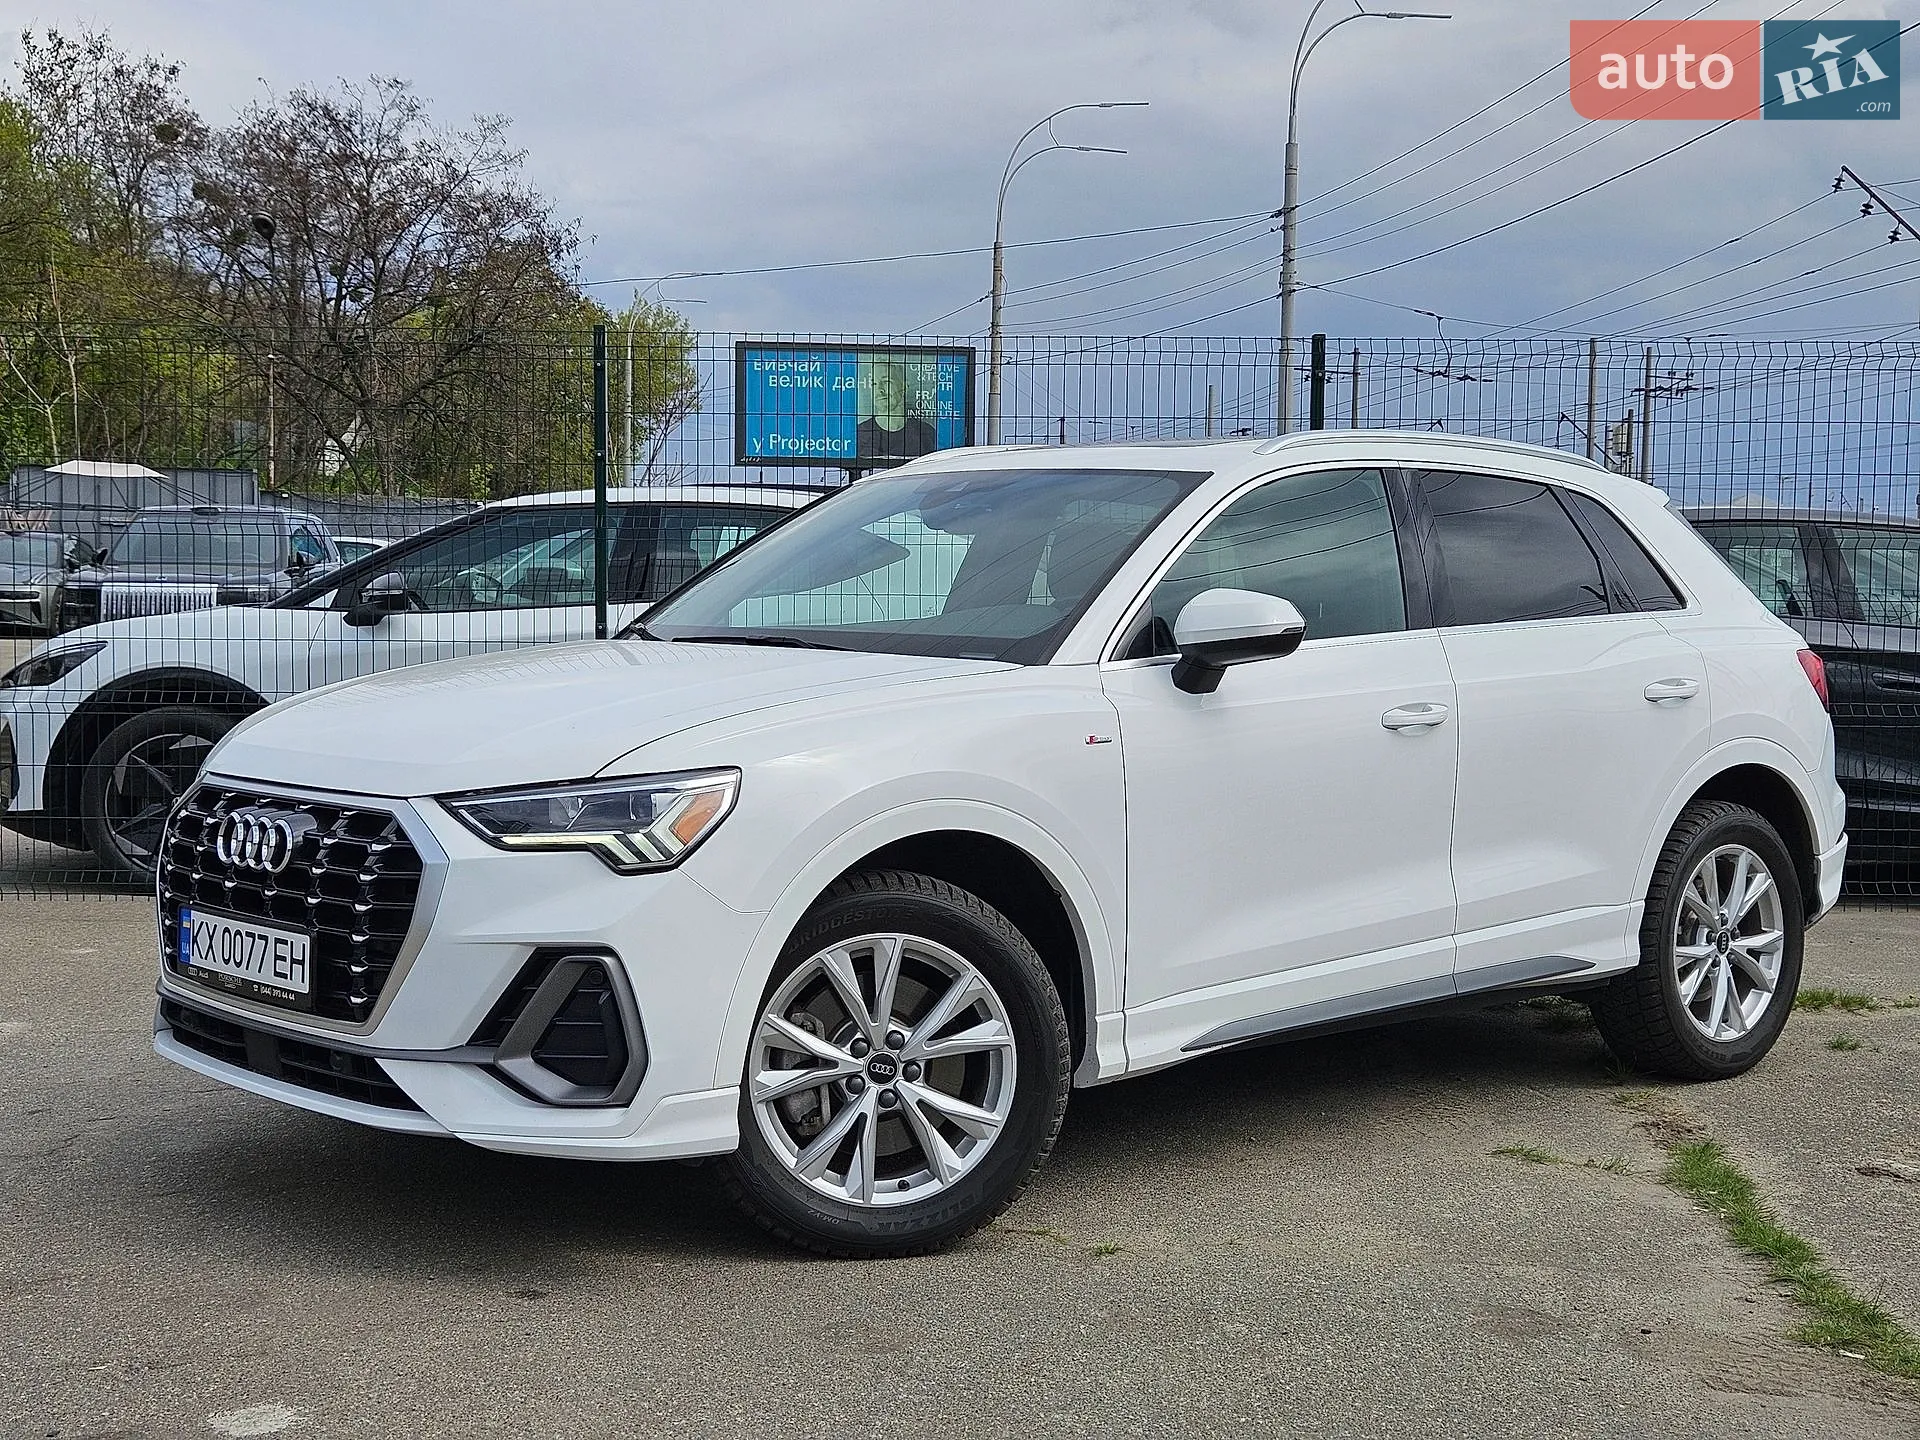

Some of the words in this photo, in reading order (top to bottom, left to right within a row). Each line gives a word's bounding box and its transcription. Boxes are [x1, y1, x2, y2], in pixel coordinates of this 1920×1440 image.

[768, 433, 852, 454] Projector
[191, 918, 218, 963] KX
[221, 926, 269, 975] 0077
[273, 936, 306, 984] EH
